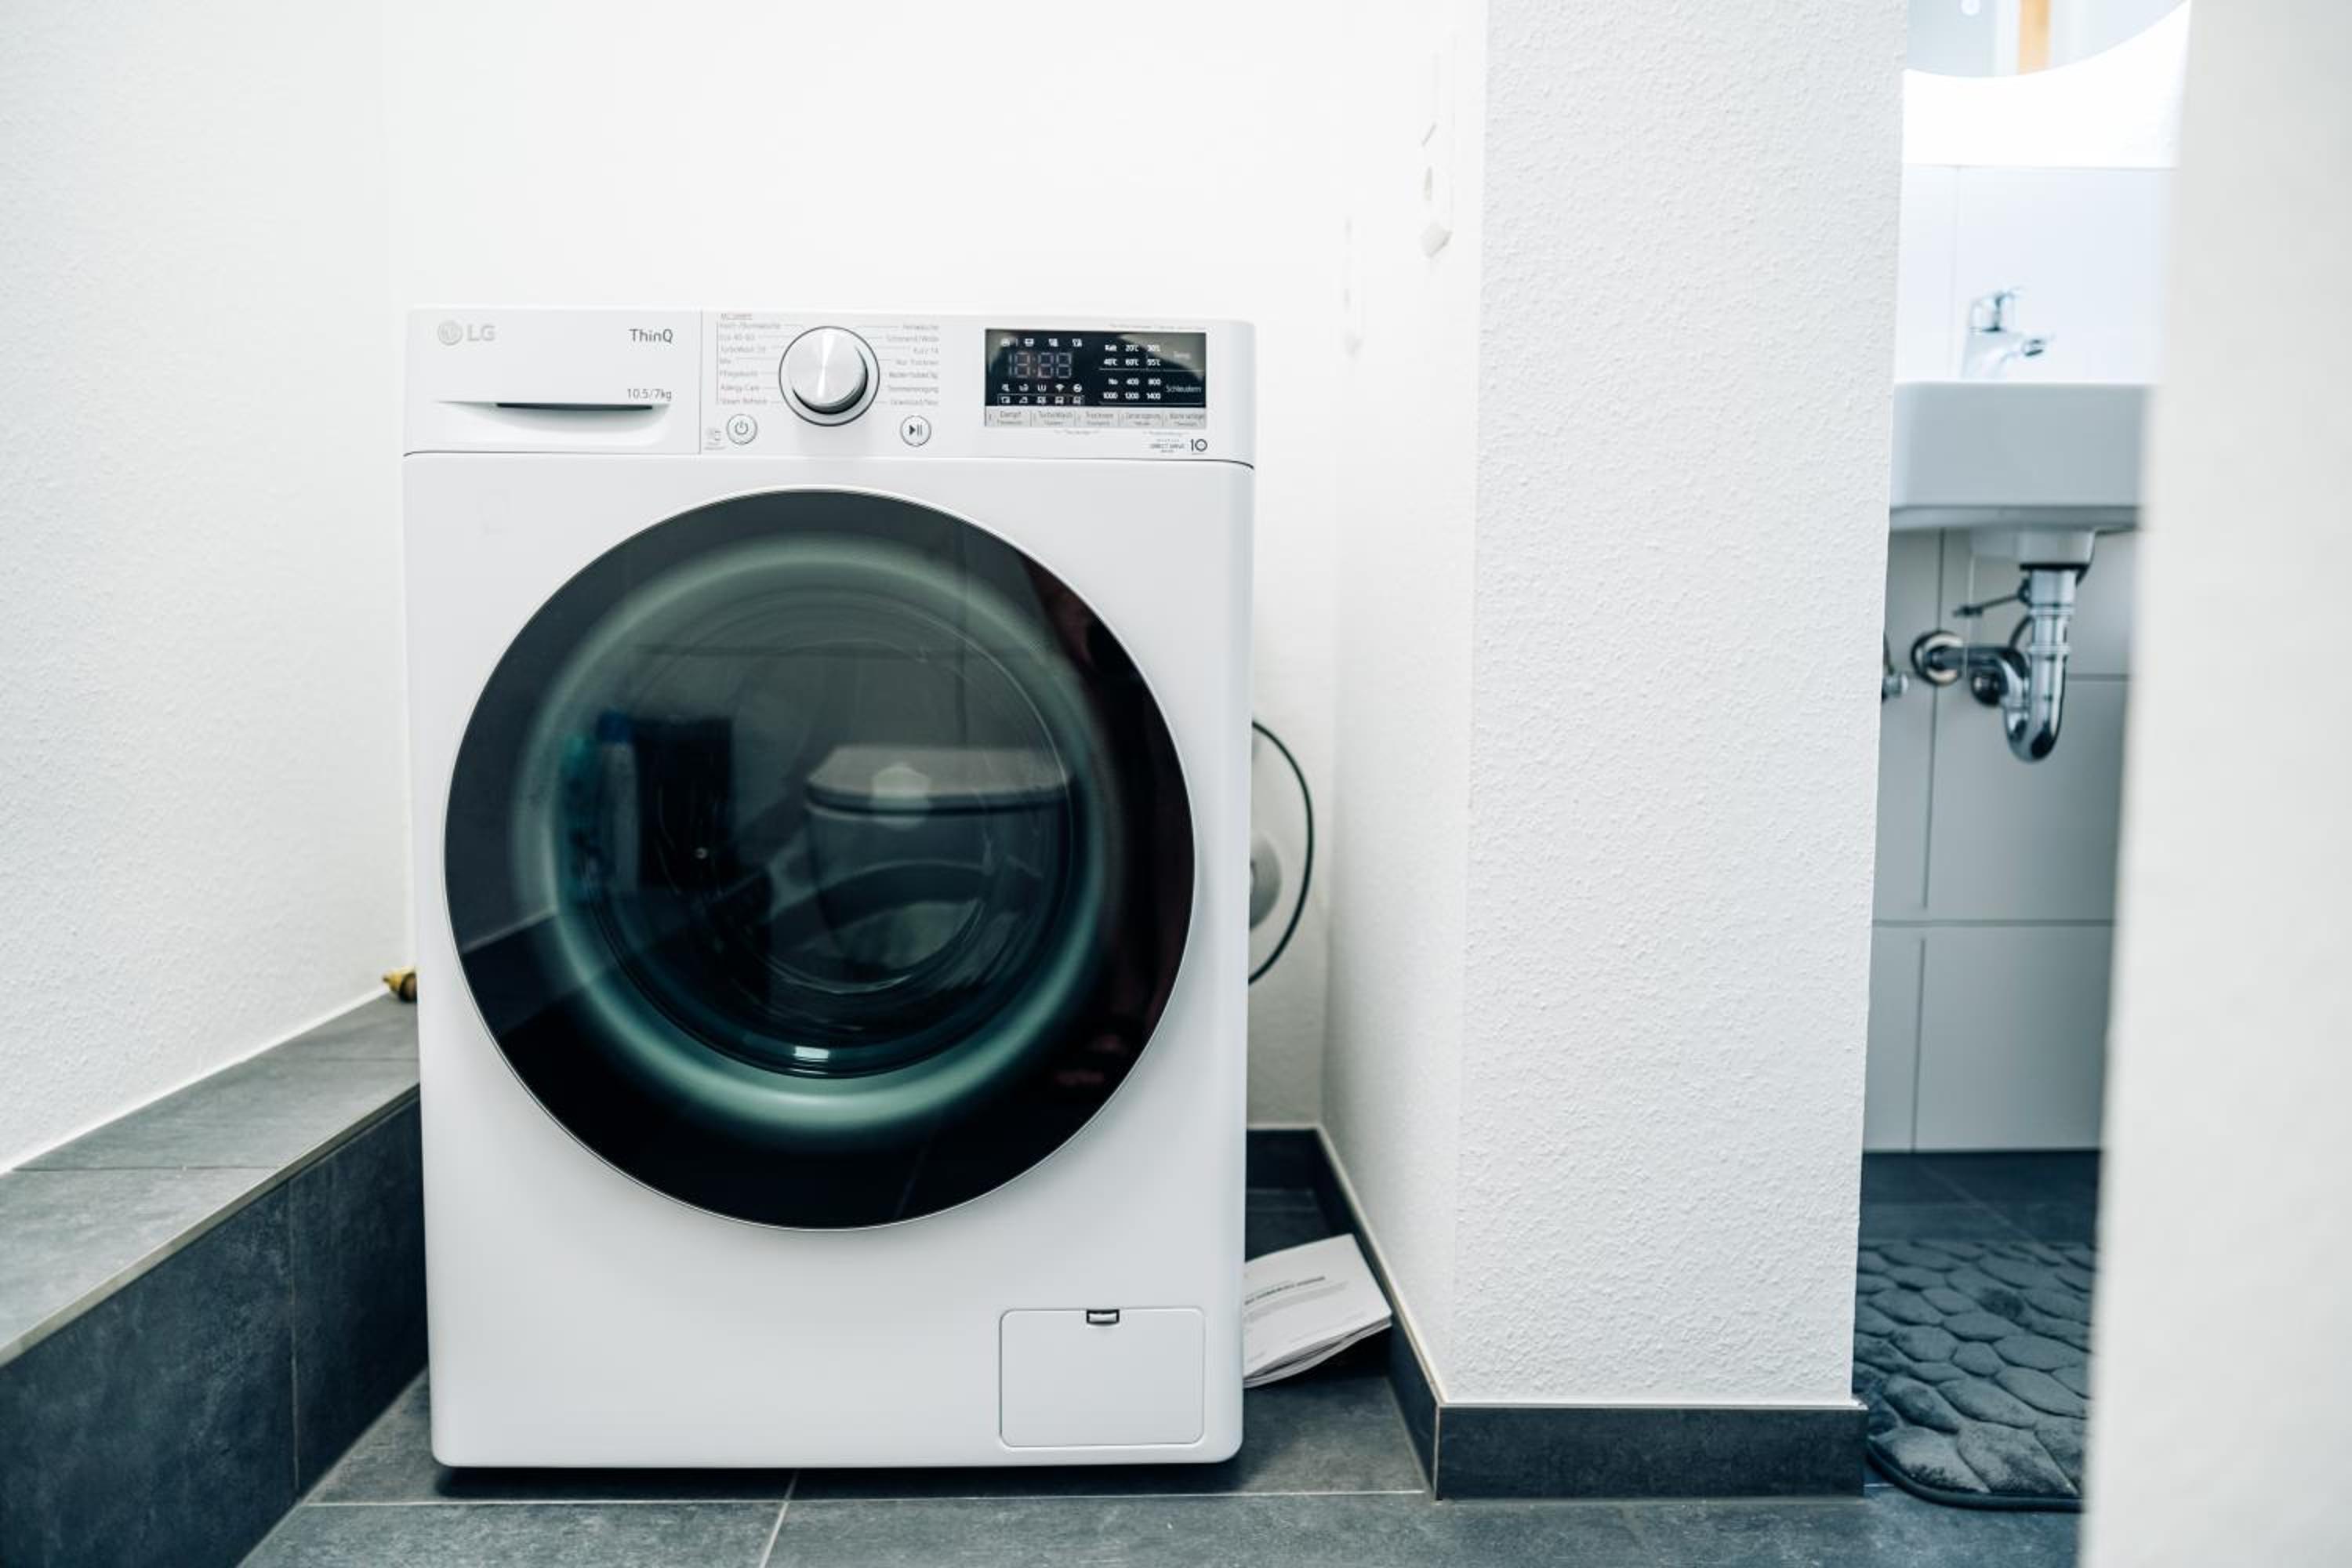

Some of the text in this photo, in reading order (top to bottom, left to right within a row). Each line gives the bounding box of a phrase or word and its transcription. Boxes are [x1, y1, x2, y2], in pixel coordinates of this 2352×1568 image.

[467, 325, 495, 342] LG
[630, 328, 673, 344] ThinQ
[627, 389, 672, 401] 10.5/7kg
